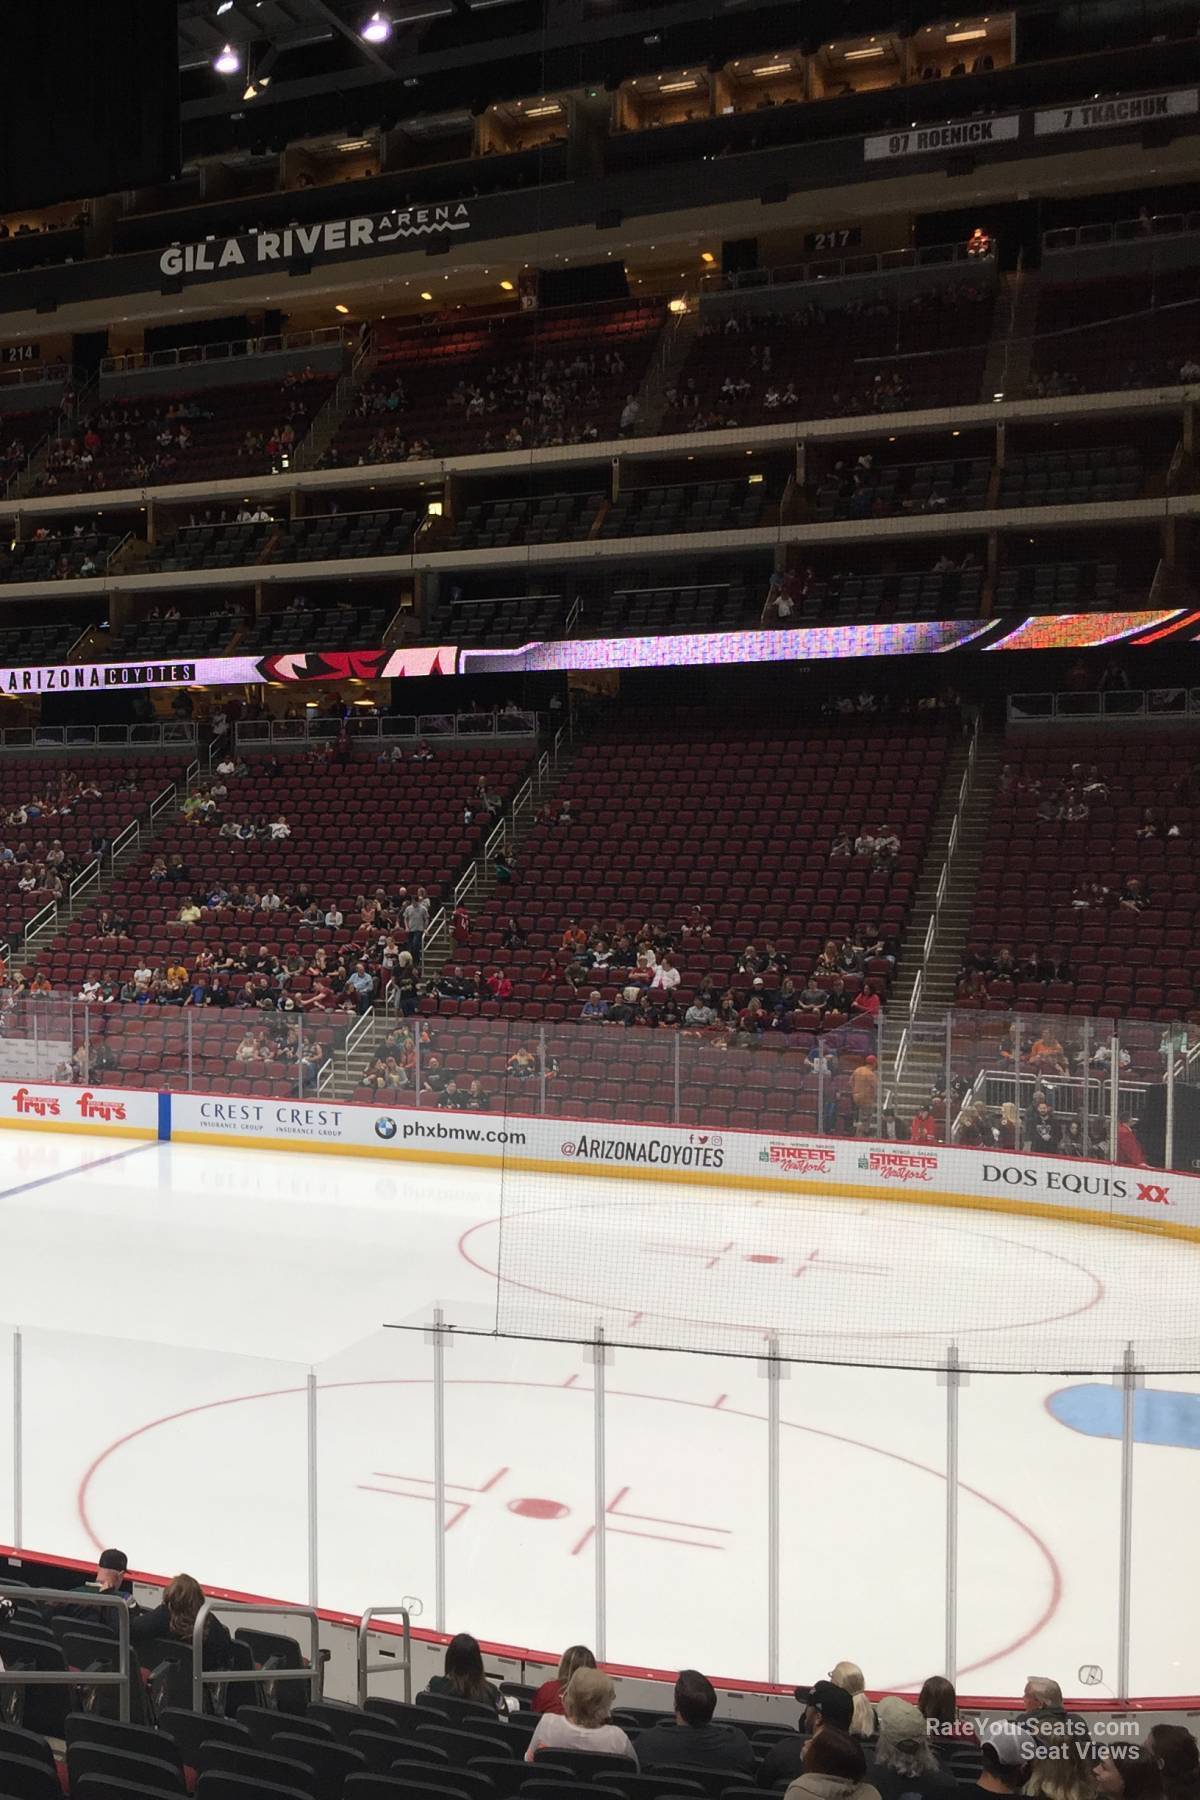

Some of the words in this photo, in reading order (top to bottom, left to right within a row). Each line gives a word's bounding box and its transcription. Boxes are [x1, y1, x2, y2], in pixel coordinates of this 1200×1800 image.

[1063, 110, 1073, 128] 7
[1080, 96, 1168, 125] TKACHUK
[917, 122, 993, 149] ROENICK
[379, 204, 468, 229] ARENA
[159, 238, 245, 275] GILA
[257, 217, 374, 261] RIVER
[815, 230, 850, 250] 217
[9, 346, 33, 361] 214
[8, 666, 99, 693] ARIZONA
[109, 665, 191, 684] COYOTES
[12, 1088, 61, 1116] fry's
[75, 1092, 126, 1120] fry's
[200, 1102, 263, 1121] CREST
[200, 1121, 237, 1129] INSURANCE
[276, 1107, 342, 1126] CREST
[276, 1127, 314, 1135] INSURANCE
[402, 1121, 526, 1145] phxbmw.com
[770, 1146, 835, 1162] STREETS
[869, 1152, 937, 1169] STREETS
[982, 1164, 1037, 1187] DOS
[1046, 1171, 1127, 1198] EQUIS
[1136, 1183, 1170, 1205] XX
